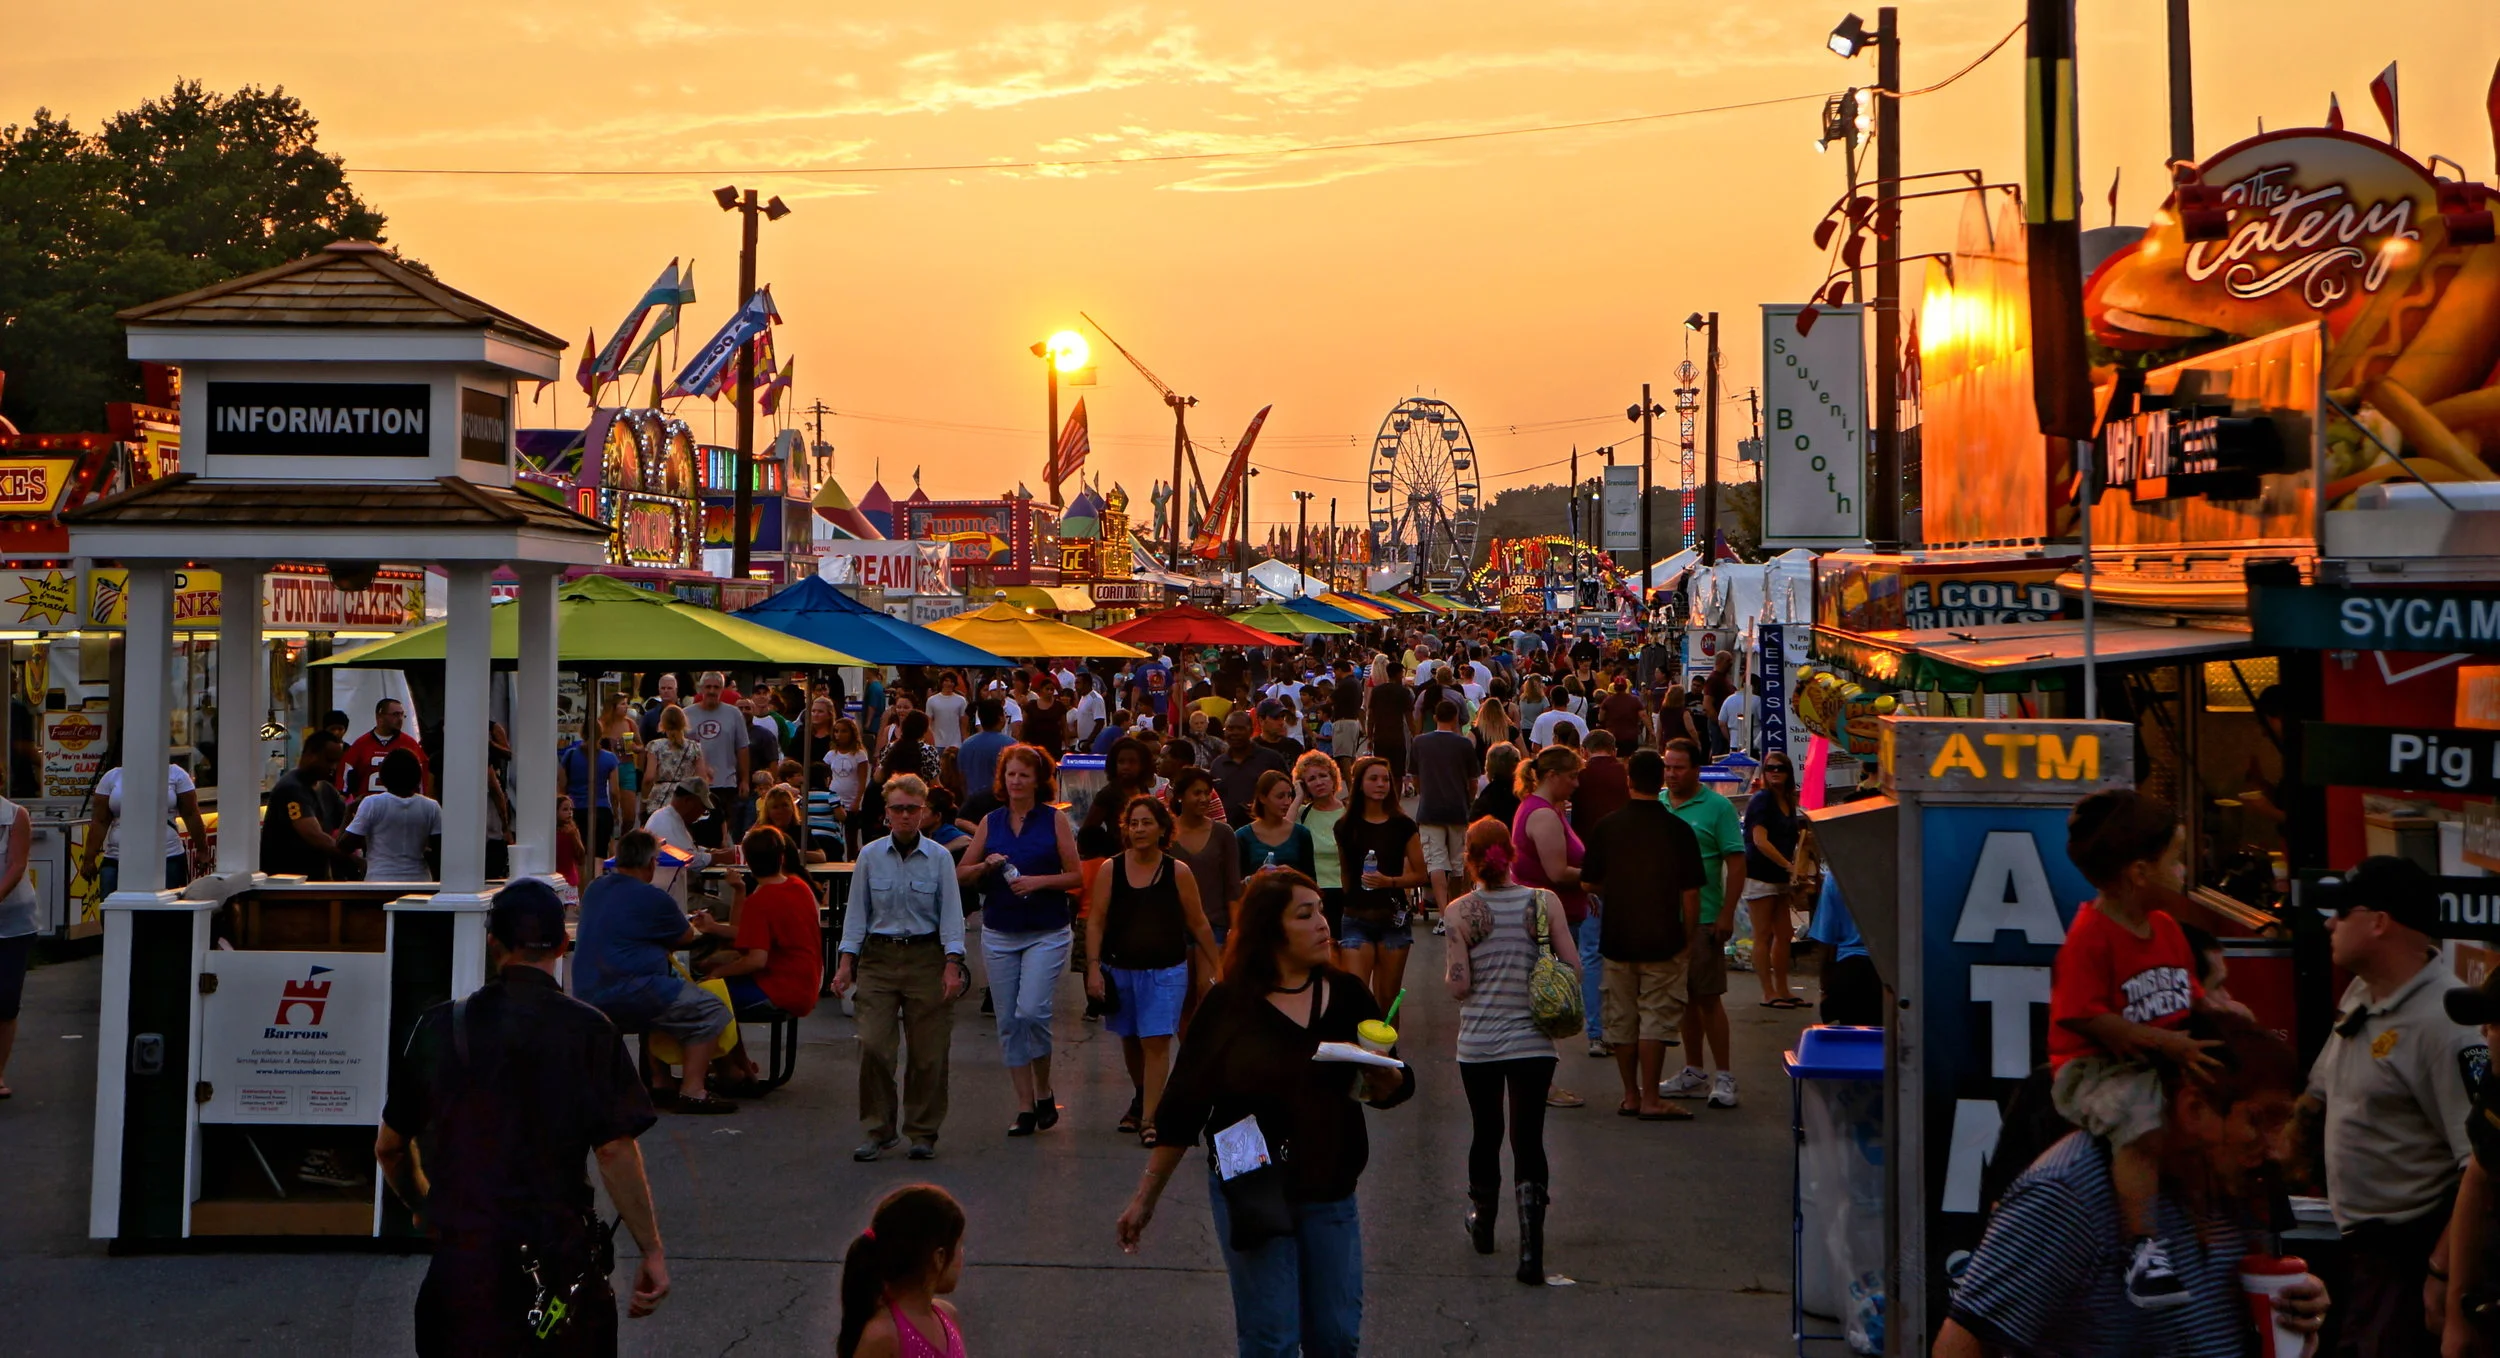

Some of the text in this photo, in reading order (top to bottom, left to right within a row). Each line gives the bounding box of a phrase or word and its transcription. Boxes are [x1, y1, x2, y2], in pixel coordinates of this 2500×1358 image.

[2243, 166, 2291, 207] The
[1773, 338, 1856, 442] Souvenir
[216, 406, 424, 434] INFORMATION
[1776, 408, 1852, 515] Booth
[912, 511, 1009, 535] Funnel
[38, 579, 69, 594] Made
[1509, 575, 1536, 585] FRIED
[40, 593, 65, 603] from
[271, 578, 339, 624] FUNNEL
[343, 580, 404, 625] CAKES
[1096, 586, 1123, 599] CORN
[1941, 583, 2061, 612] COLD
[28, 595, 70, 613] Scratch
[916, 605, 961, 621] FLOATS
[51, 726, 77, 738] Funnel
[1928, 733, 2100, 780] ATM
[2389, 733, 2473, 788] Pig
[263, 1028, 328, 1039] Barrons
[291, 1049, 316, 1057] Building
